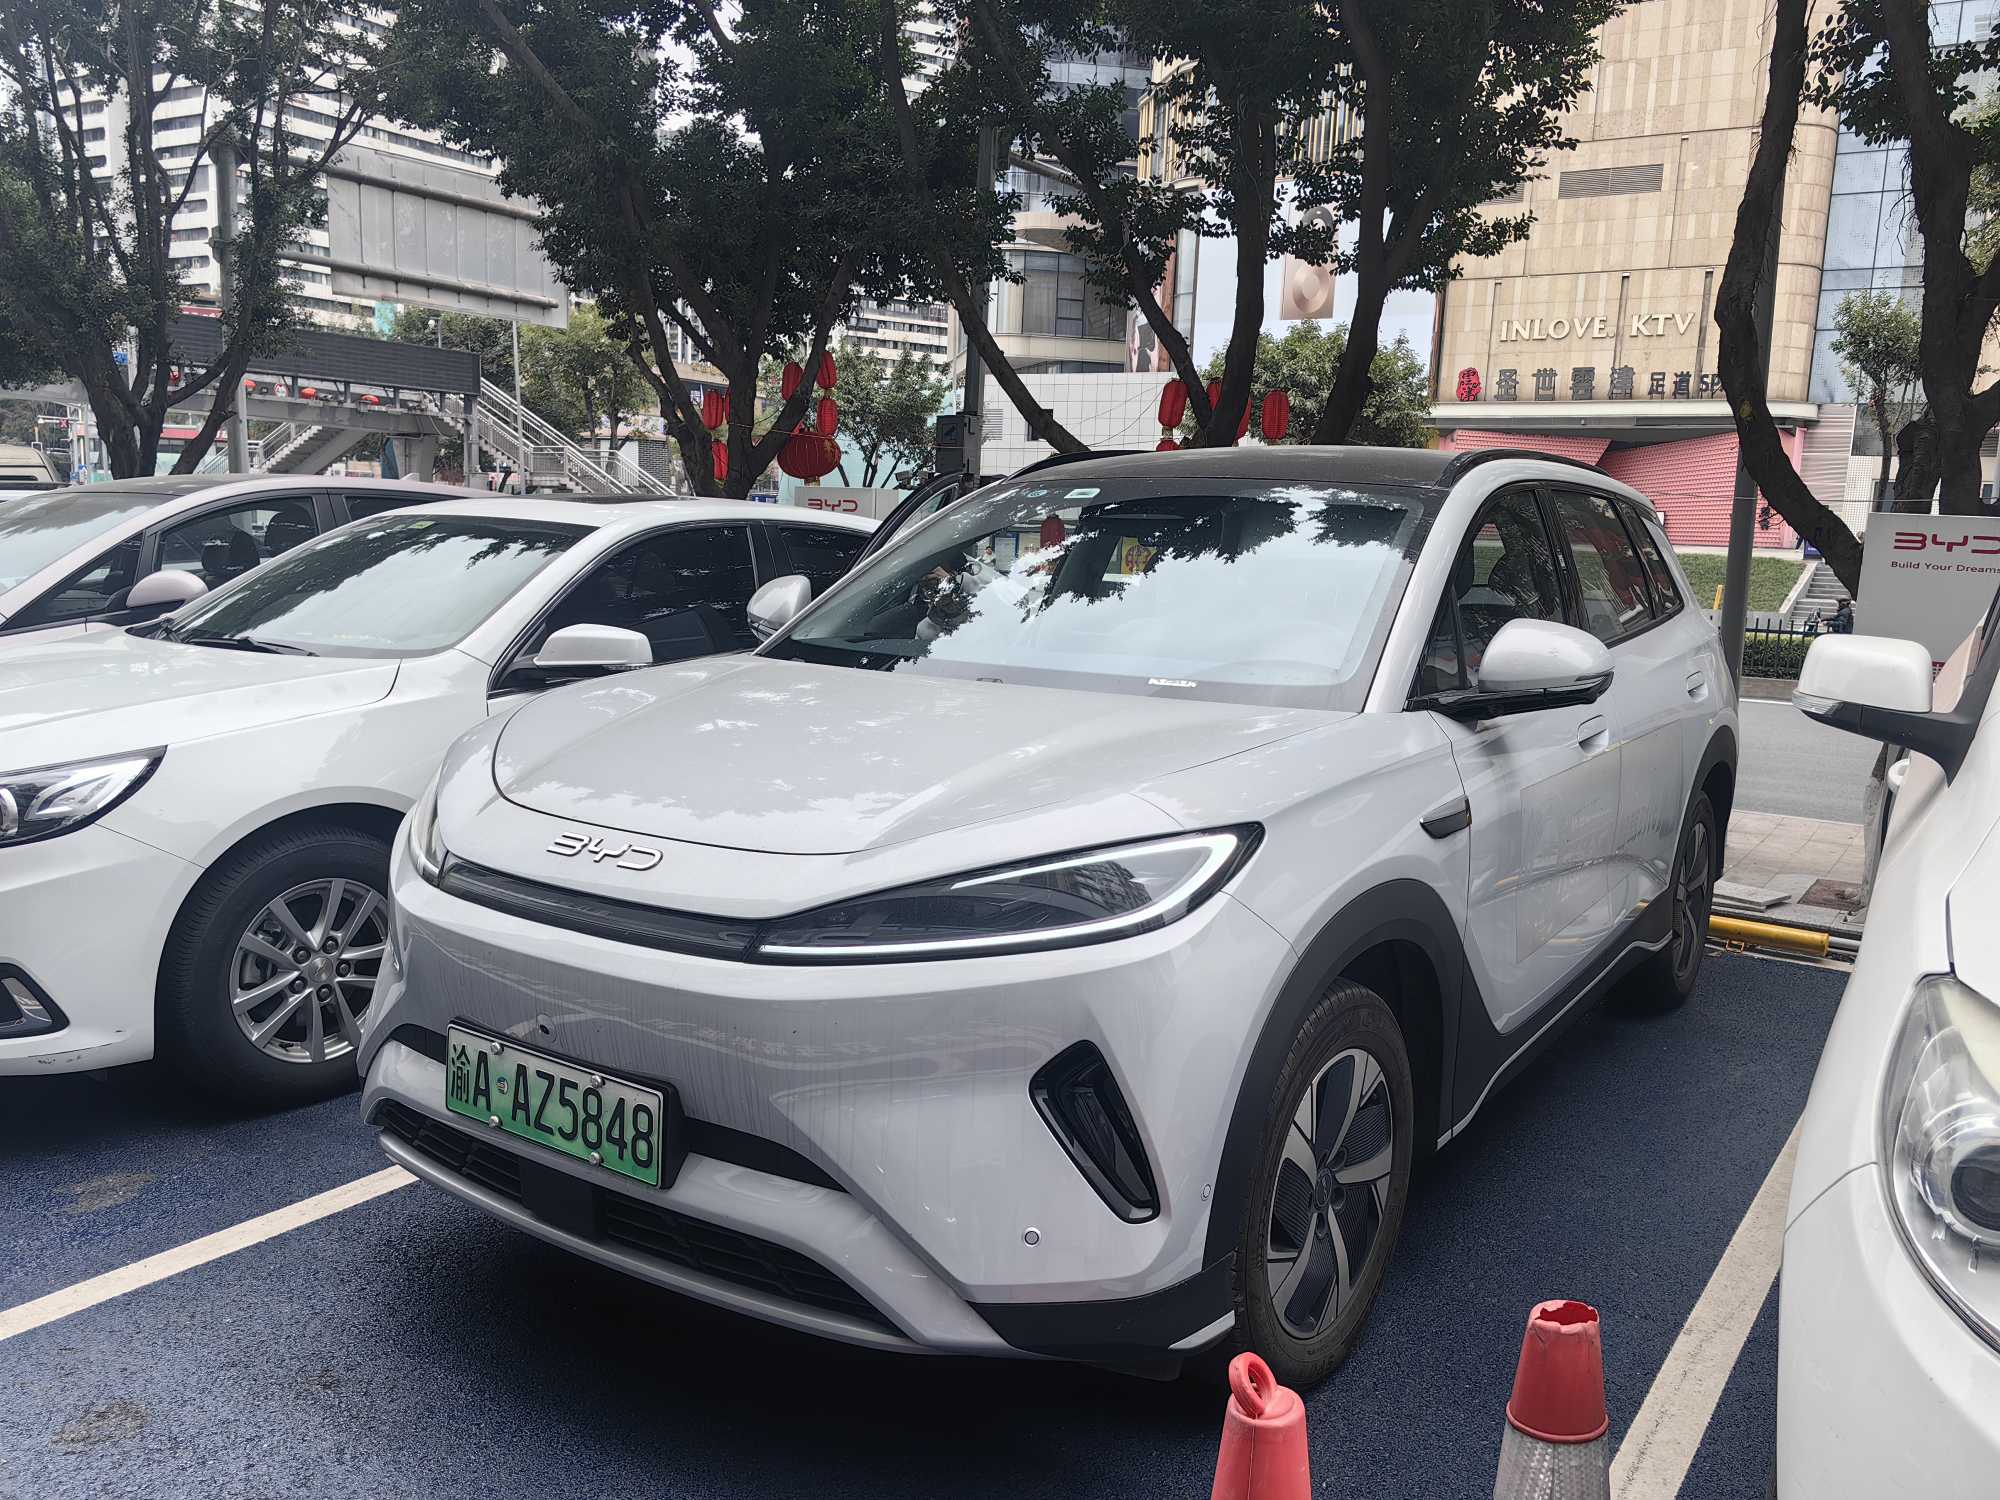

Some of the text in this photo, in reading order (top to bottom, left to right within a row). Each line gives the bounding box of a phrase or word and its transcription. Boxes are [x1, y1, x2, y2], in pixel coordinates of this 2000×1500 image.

[1629, 311, 1696, 338] KTV
[808, 498, 858, 512] BYD
[1891, 560, 1920, 570] Build
[1924, 562, 1953, 572] Your
[546, 831, 664, 871] BYD
